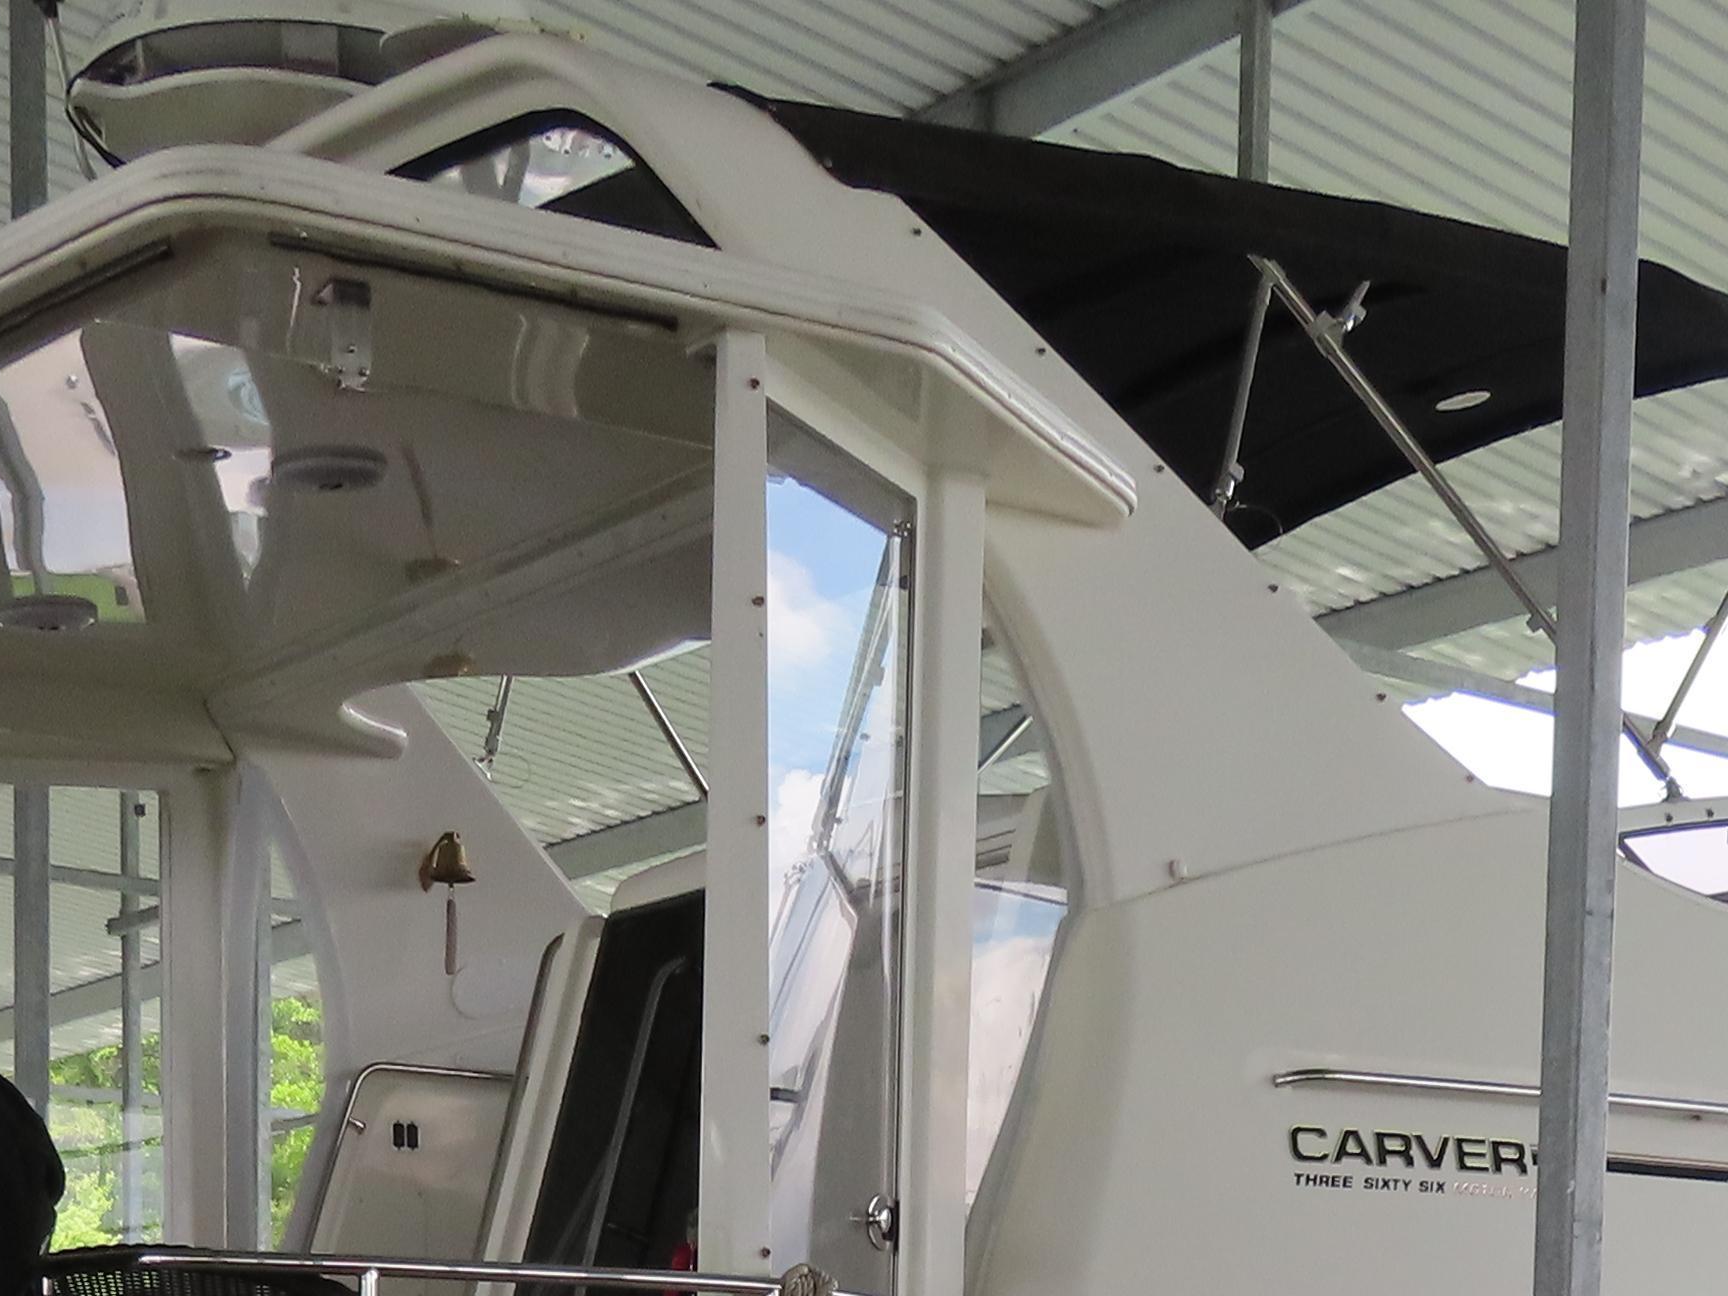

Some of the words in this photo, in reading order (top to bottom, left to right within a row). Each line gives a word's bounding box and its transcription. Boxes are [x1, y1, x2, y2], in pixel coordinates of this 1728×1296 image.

[1289, 1124, 1529, 1175] CARVER
[1293, 1172, 1353, 1189] THREE
[1363, 1177, 1413, 1192] SIXTY
[1419, 1180, 1446, 1194] SIX
